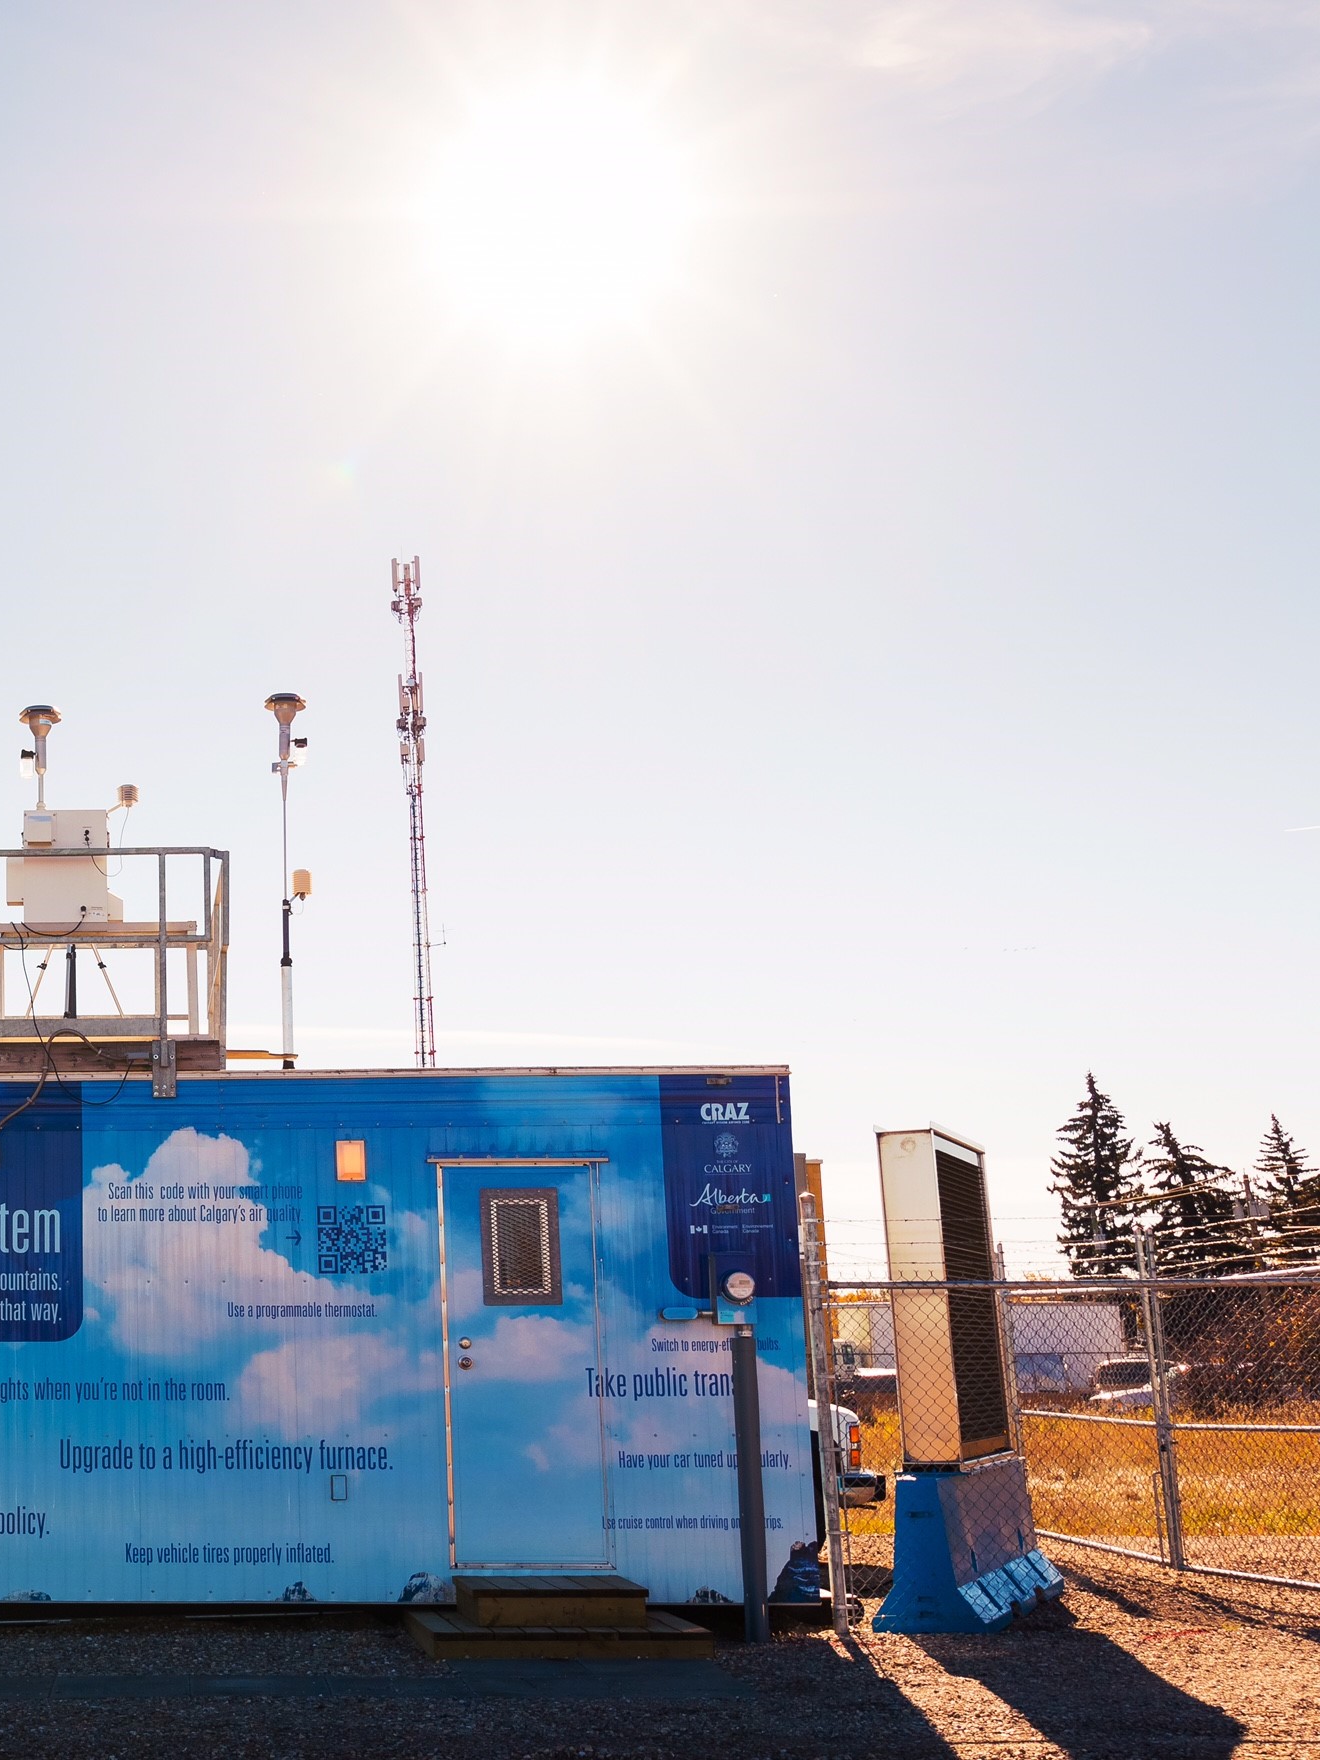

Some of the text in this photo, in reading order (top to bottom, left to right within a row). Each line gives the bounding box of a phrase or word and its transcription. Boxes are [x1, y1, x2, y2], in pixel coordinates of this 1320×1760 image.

[700, 1102, 750, 1121] CRAZ
[703, 1163, 752, 1174] CALGARY
[108, 1182, 303, 1202] Scan this code with your smart phone
[689, 1183, 768, 1207] Alberta
[97, 1204, 304, 1224] to learn more about Calgary's air quality.
[0, 1299, 26, 1322] that
[30, 1303, 62, 1324] way.
[228, 1302, 378, 1319] Use a programmable thermostat.
[651, 1338, 679, 1352] Switch
[681, 1339, 689, 1352] to
[34, 1378, 71, 1401] when
[75, 1378, 117, 1404] you're
[122, 1379, 143, 1401] not
[148, 1378, 161, 1400] in
[164, 1378, 187, 1401] the
[191, 1383, 230, 1401] room.
[585, 1367, 627, 1397] Take
[633, 1367, 688, 1402] public
[59, 1439, 393, 1473] Upgrade to a high-efficiency furnace.
[618, 1450, 644, 1468] Have
[647, 1454, 671, 1470] your
[673, 1454, 691, 1468] car
[694, 1450, 723, 1468] tuned
[618, 1515, 643, 1529] cruise
[645, 1515, 674, 1529] control
[675, 1515, 698, 1529] when
[700, 1515, 729, 1530] driving
[731, 1517, 740, 1529] on
[765, 1514, 783, 1530] rips.
[125, 1542, 334, 1566] Keep vehicle tires properly inflated.
